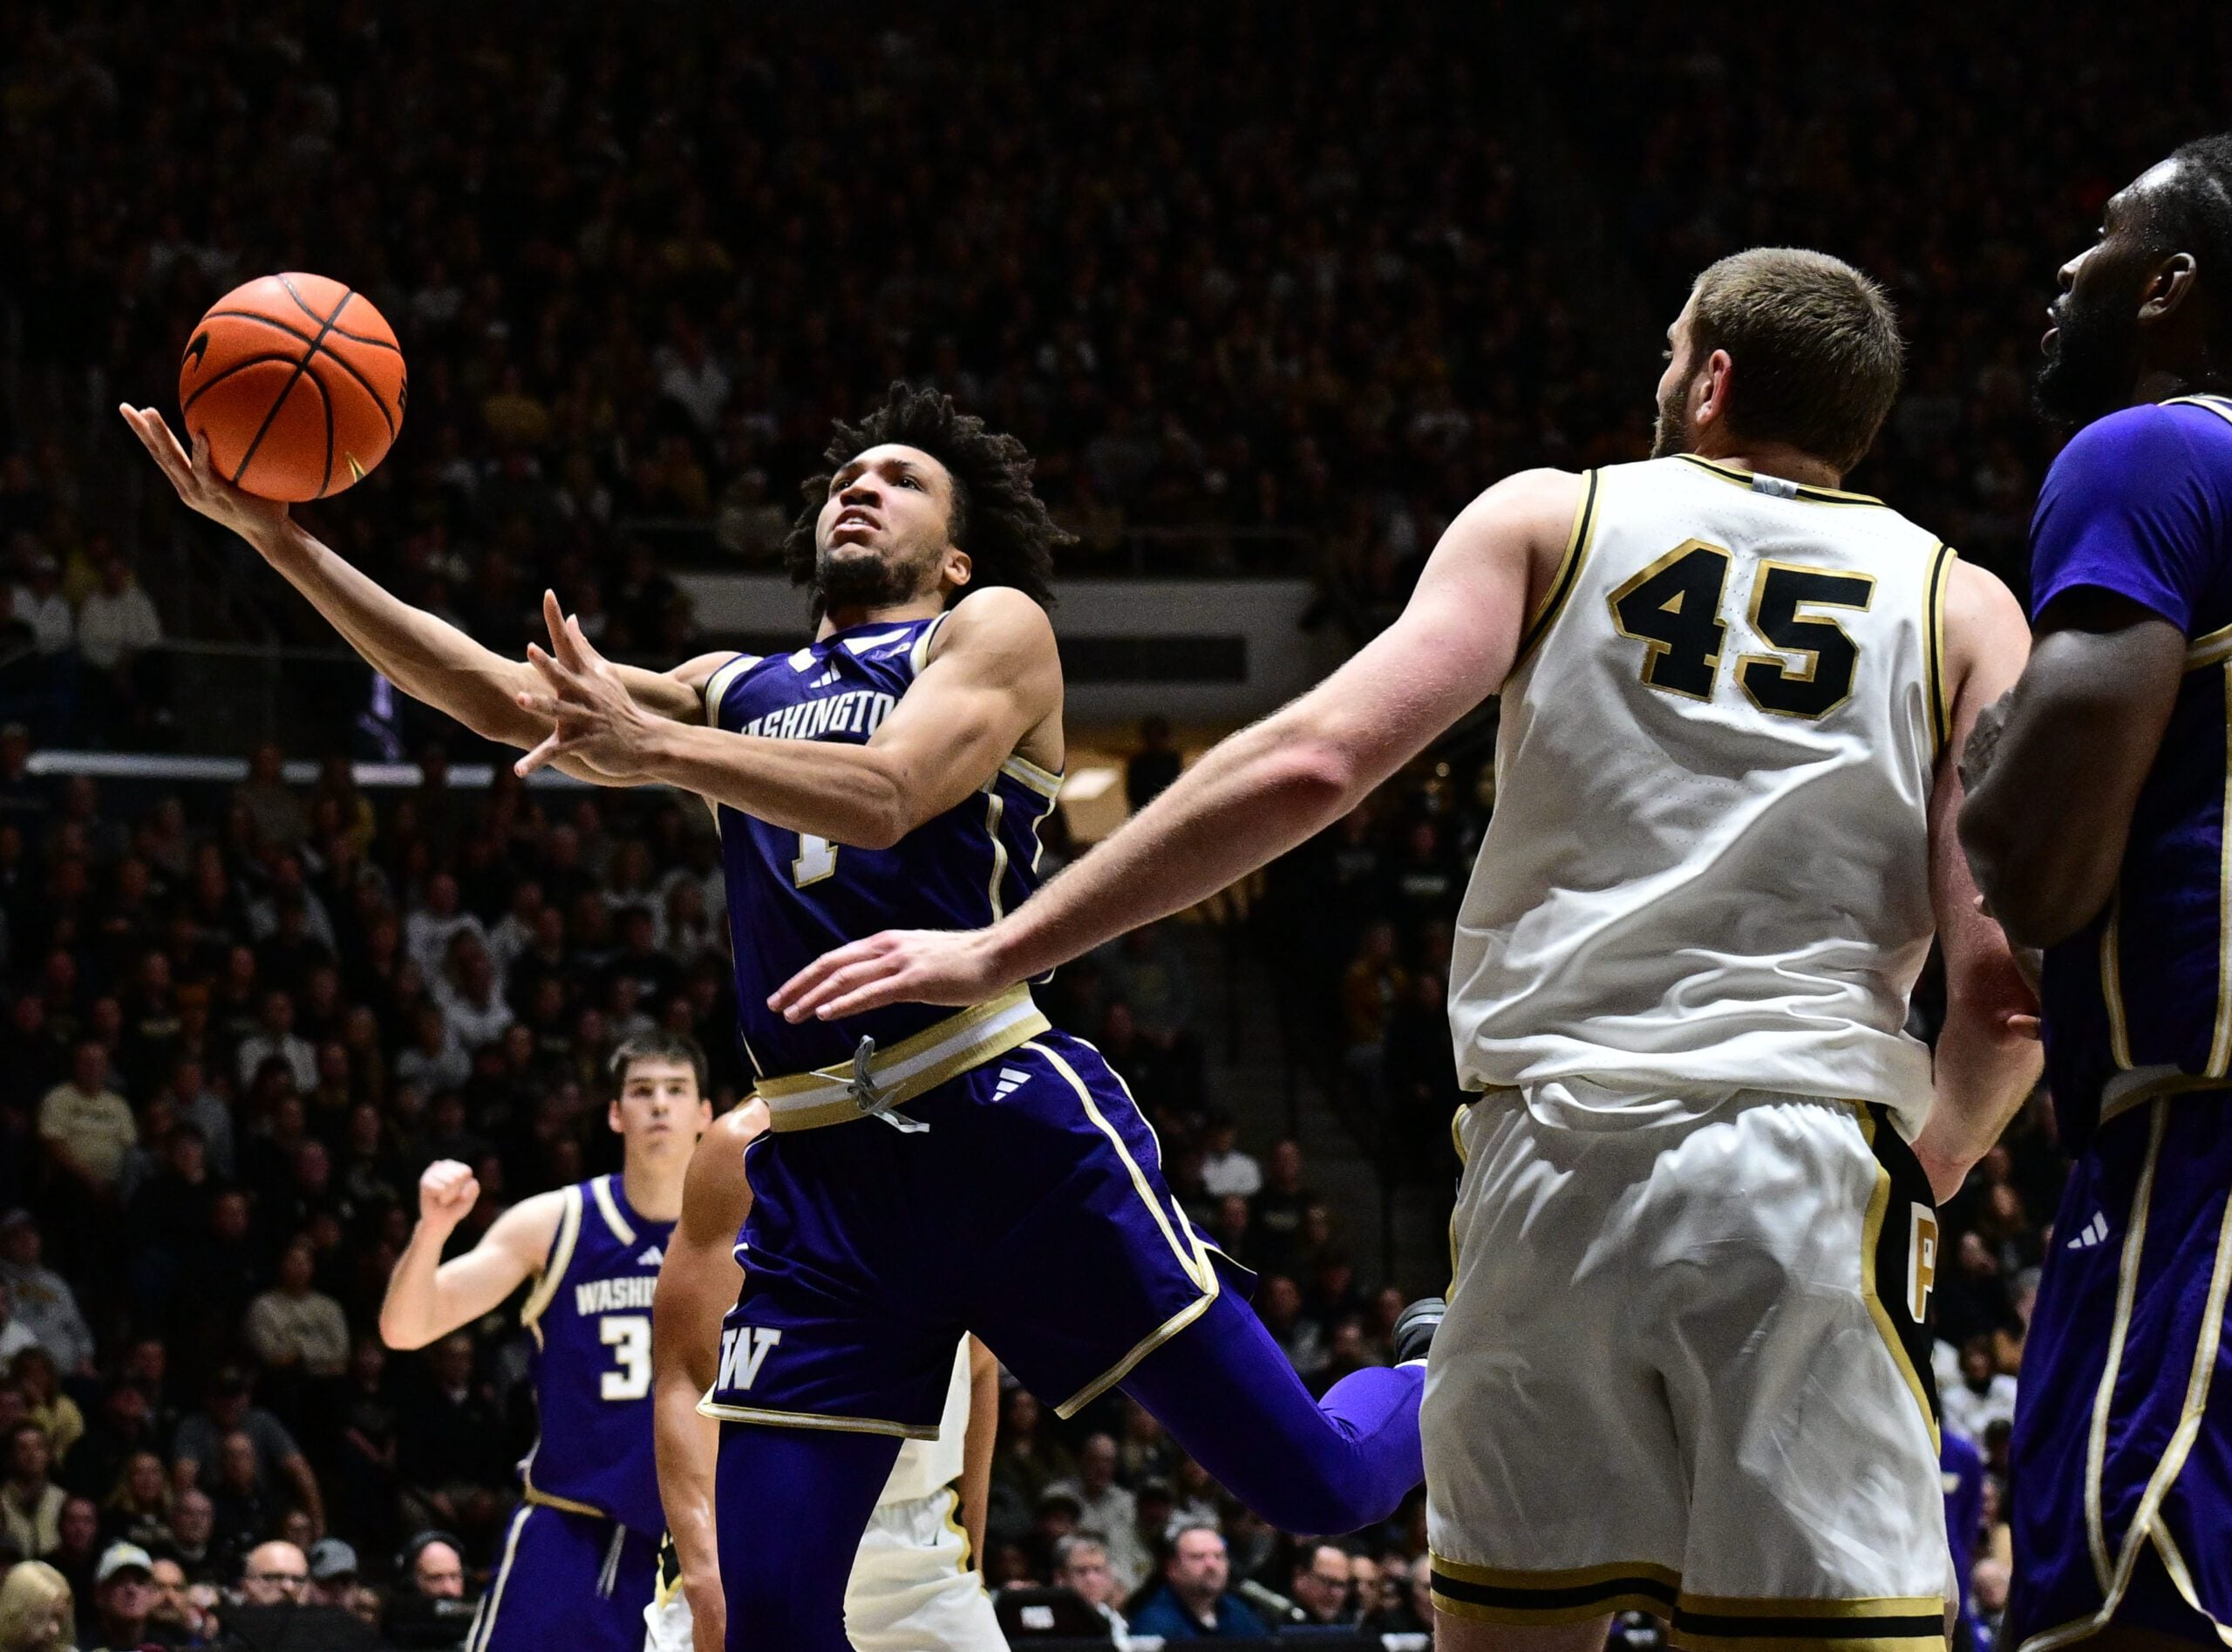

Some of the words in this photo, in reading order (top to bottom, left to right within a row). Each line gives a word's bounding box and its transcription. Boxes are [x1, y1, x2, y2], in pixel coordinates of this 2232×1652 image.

[1605, 538, 1877, 720] 45
[741, 690, 902, 740] ASHINGTO
[792, 833, 839, 889] 1
[1907, 1200, 1939, 1324] P
[599, 1315, 653, 1402] 3
[717, 1325, 782, 1391] W
